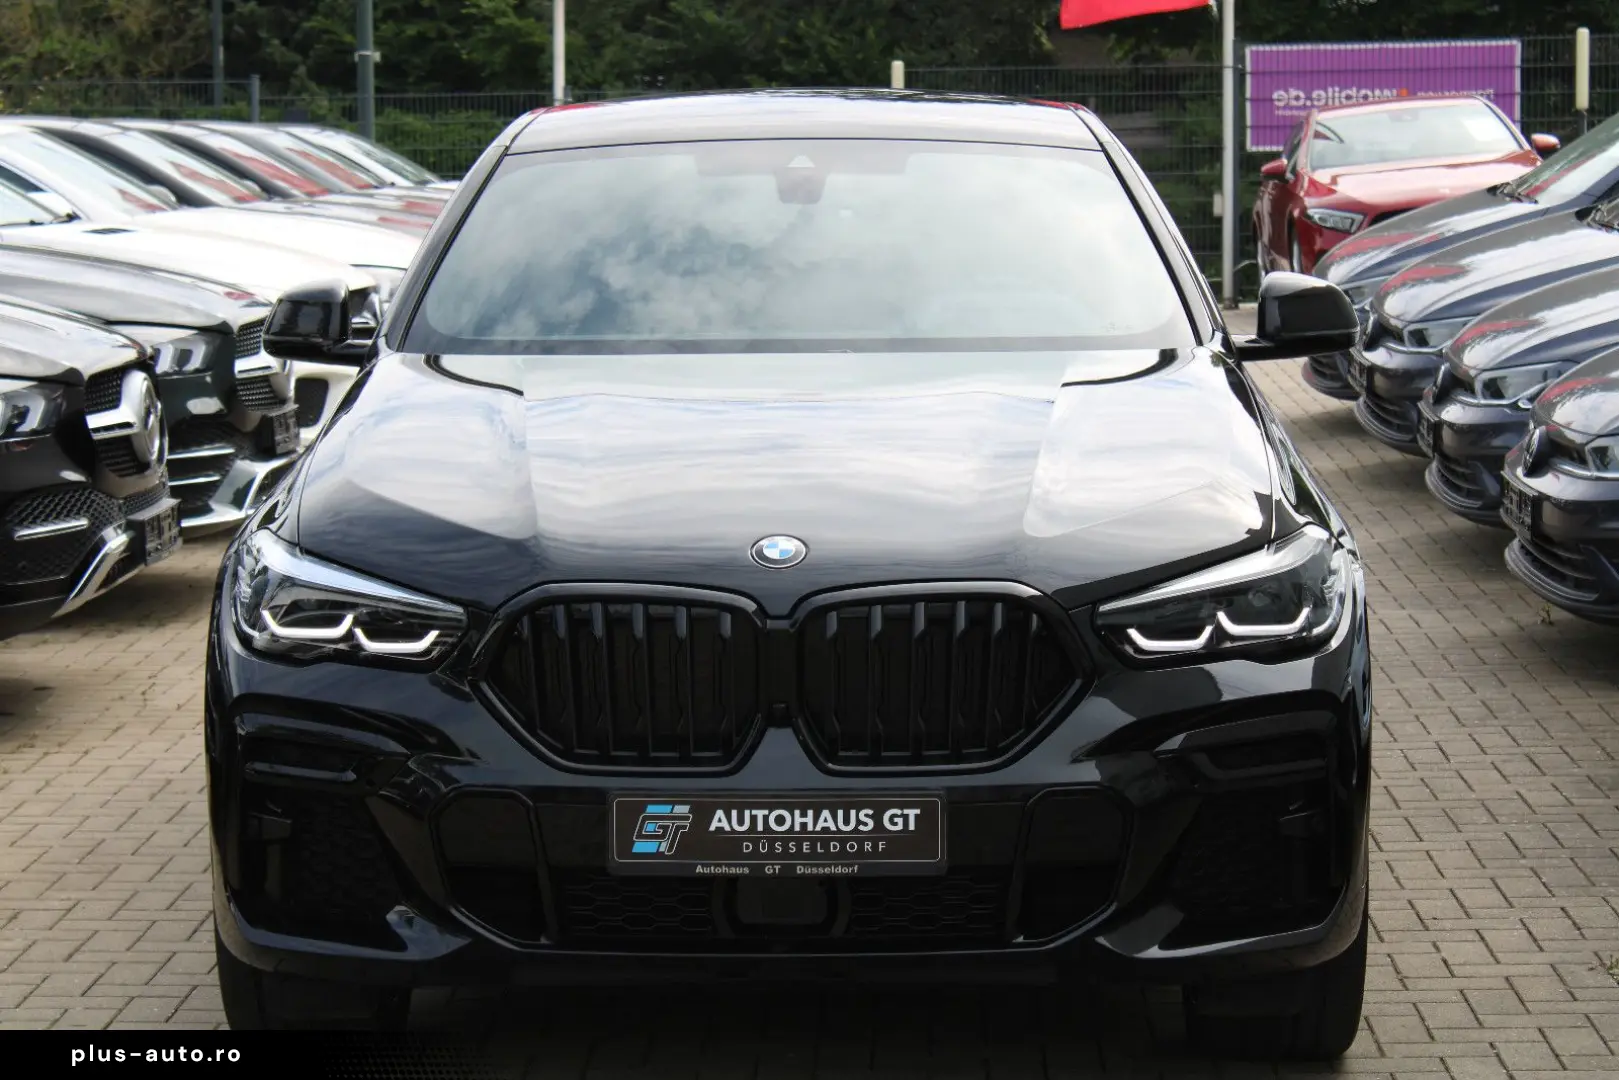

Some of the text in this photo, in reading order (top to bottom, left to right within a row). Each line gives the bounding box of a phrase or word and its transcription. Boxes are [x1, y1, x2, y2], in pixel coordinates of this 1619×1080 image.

[708, 808, 921, 832] AUTOHAUS GT
[742, 839, 887, 853] DÜSSELDORF
[695, 865, 859, 875] Autohaus GT Düsseldorf
